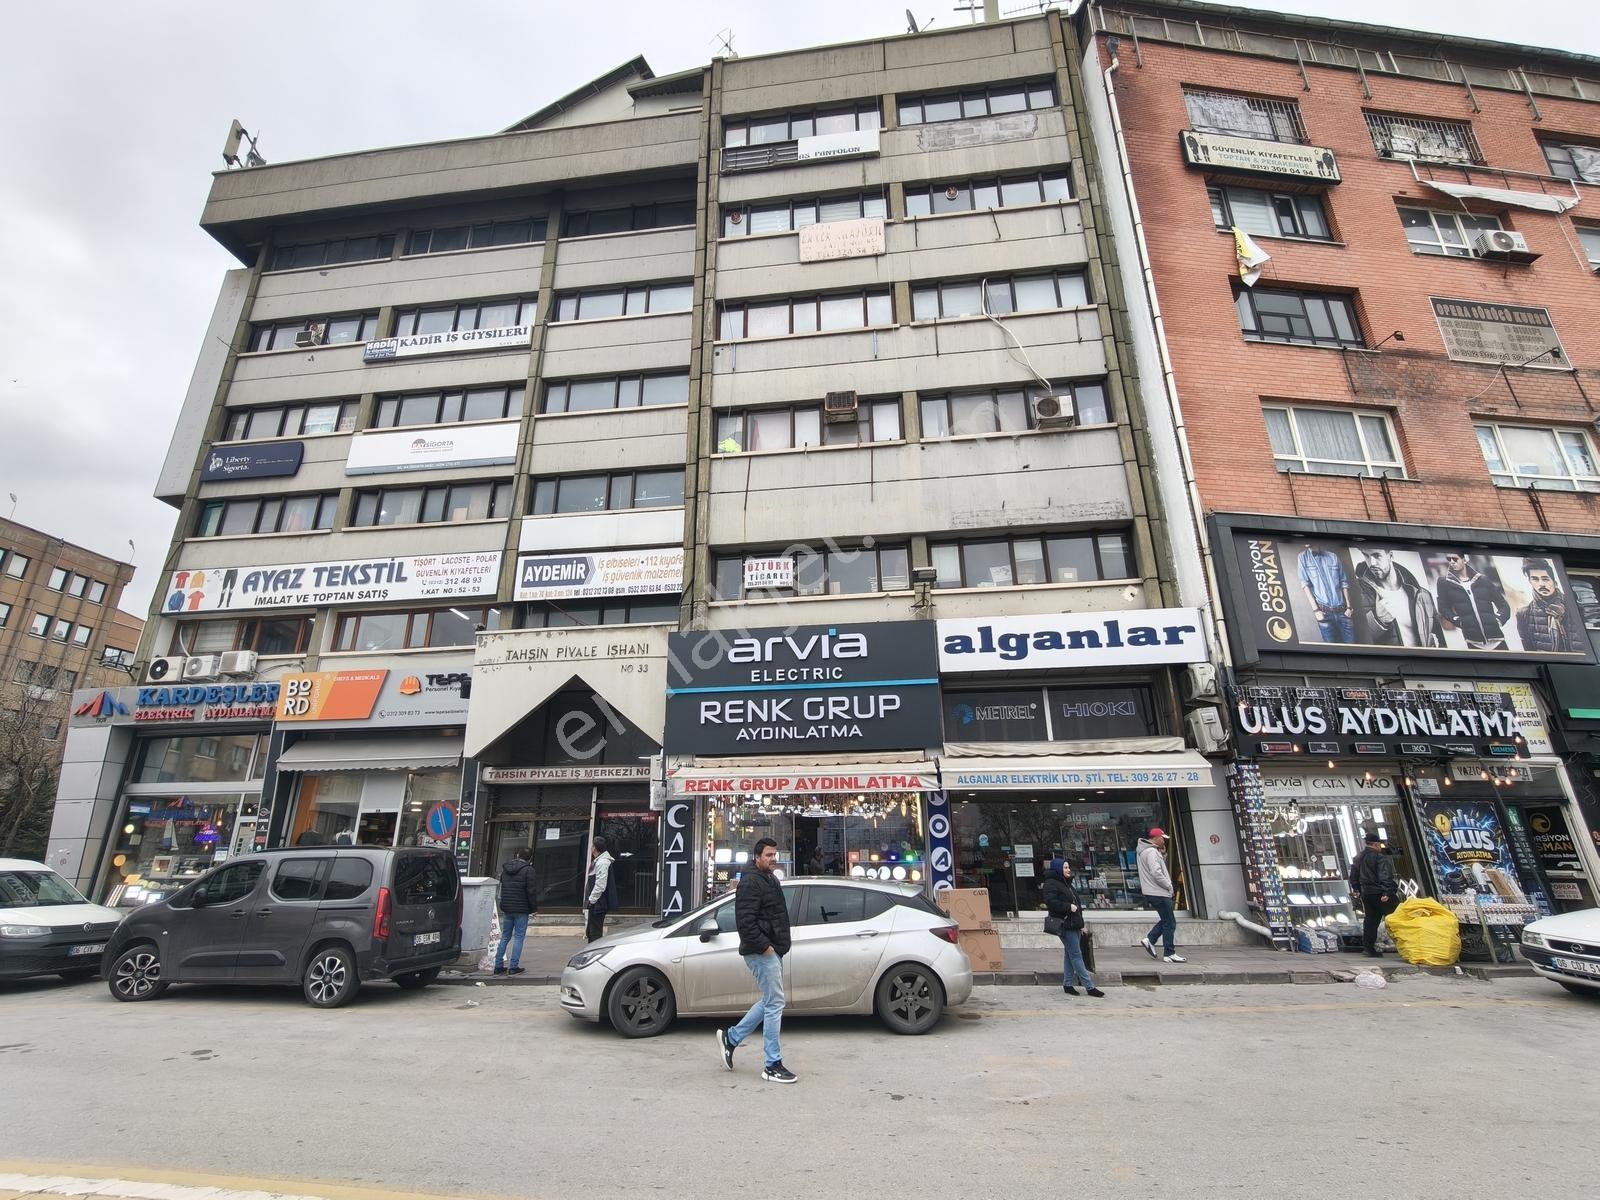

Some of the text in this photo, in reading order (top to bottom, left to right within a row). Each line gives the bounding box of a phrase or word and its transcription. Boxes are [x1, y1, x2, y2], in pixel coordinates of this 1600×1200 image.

[1211, 144, 1313, 163] GÜVENLİK KIYAFETLERİ
[1270, 165, 1288, 174] 309
[1436, 304, 1472, 318] OPERA
[399, 335, 442, 348] KADİR
[446, 333, 459, 344] İŞ
[462, 326, 529, 343] GİYSİLERİ
[225, 456, 251, 465] Liberty
[441, 556, 471, 565] LACOSTE
[475, 554, 498, 563] POLAR
[747, 560, 790, 572] ÖZTÜRK
[242, 556, 409, 595] AYAZ TEKSTİL
[415, 566, 492, 578] GÜVENLİK KIYAFETLERİ
[523, 561, 586, 583] AYDEMİR
[749, 572, 790, 581] TİCARET
[1247, 540, 1275, 612] PORSİYON
[1258, 540, 1287, 613] OSMAN
[444, 578, 459, 586] 312
[472, 576, 482, 584] 93
[254, 589, 389, 606] İMALAT VE TOPTAN SATIŞ
[727, 626, 869, 664] arvia
[943, 619, 1196, 661] alganlar
[556, 646, 598, 659] PİYALE
[620, 664, 649, 673] NO 33
[751, 666, 844, 683] ELECTRIC
[135, 684, 281, 709] KARDEŞLER
[134, 707, 196, 720] ELEKTRİK
[700, 693, 901, 725] RENK GRUP
[975, 704, 1032, 721] METREL
[1062, 701, 1136, 717] HIOKI
[1239, 706, 1521, 737] ULUS AYDINLATMA
[735, 724, 864, 741] AYDINLATMA
[488, 770, 527, 780] TAHSİN
[529, 770, 567, 780] PİYALE
[957, 774, 1009, 786] ALGANLAR
[1011, 772, 1060, 785] ELEKTRİK
[1062, 773, 1084, 784] LTD.
[1086, 771, 1105, 786] ŞTİ.
[1107, 773, 1129, 783] TEL:
[1131, 772, 1150, 782] 309
[1152, 772, 1164, 782] 26
[1166, 772, 1179, 782] 27
[1187, 771, 1200, 781] 28
[1264, 776, 1302, 788] arvia
[1312, 777, 1346, 789] CATA
[683, 775, 922, 793] RENK GRUP AYDINLATMA
[1448, 829, 1495, 851] ULUS
[662, 803, 690, 918] CATA
